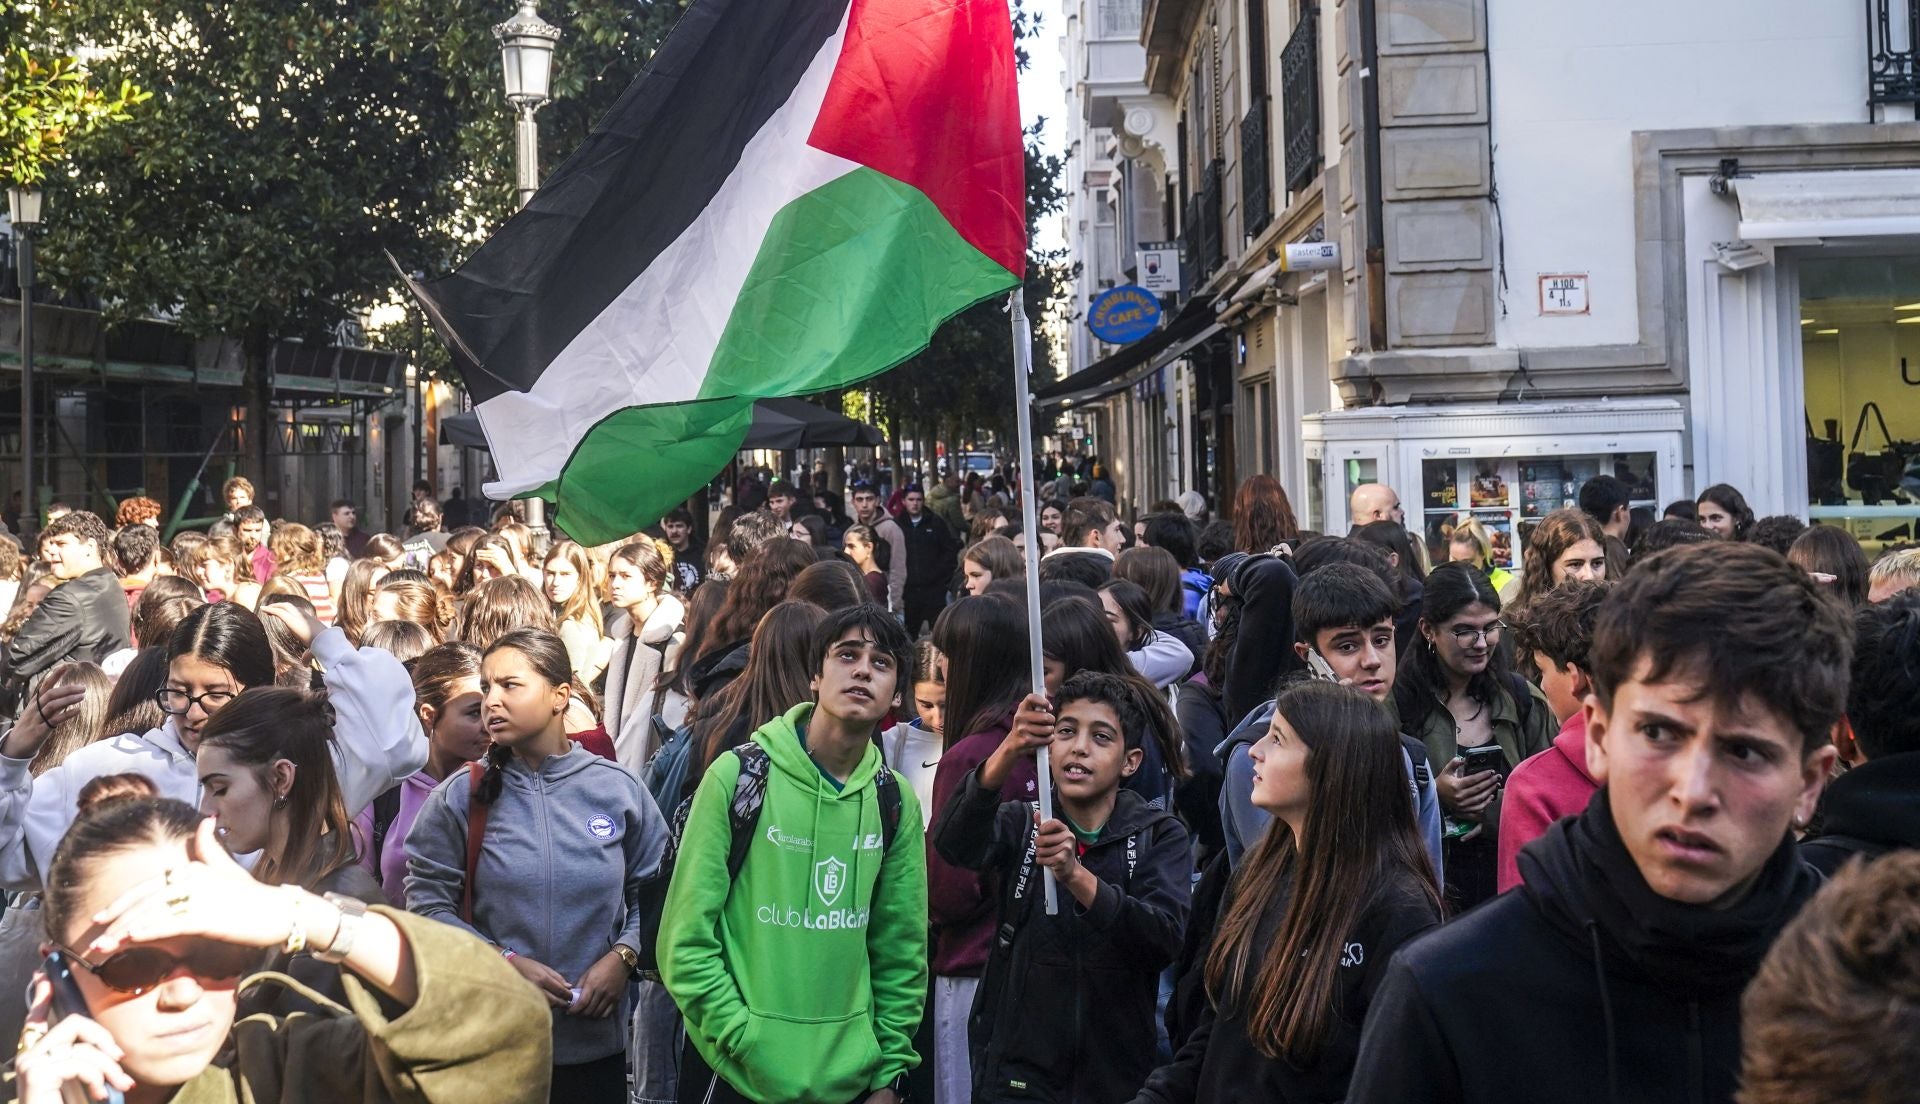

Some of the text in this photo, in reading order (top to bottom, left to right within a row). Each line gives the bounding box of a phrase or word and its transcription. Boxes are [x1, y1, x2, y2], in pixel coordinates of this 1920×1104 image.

[1561, 278, 1574, 289] 100
[1014, 875, 1027, 899] FILA
[757, 903, 801, 928] club
[803, 908, 869, 930] LaBlan
